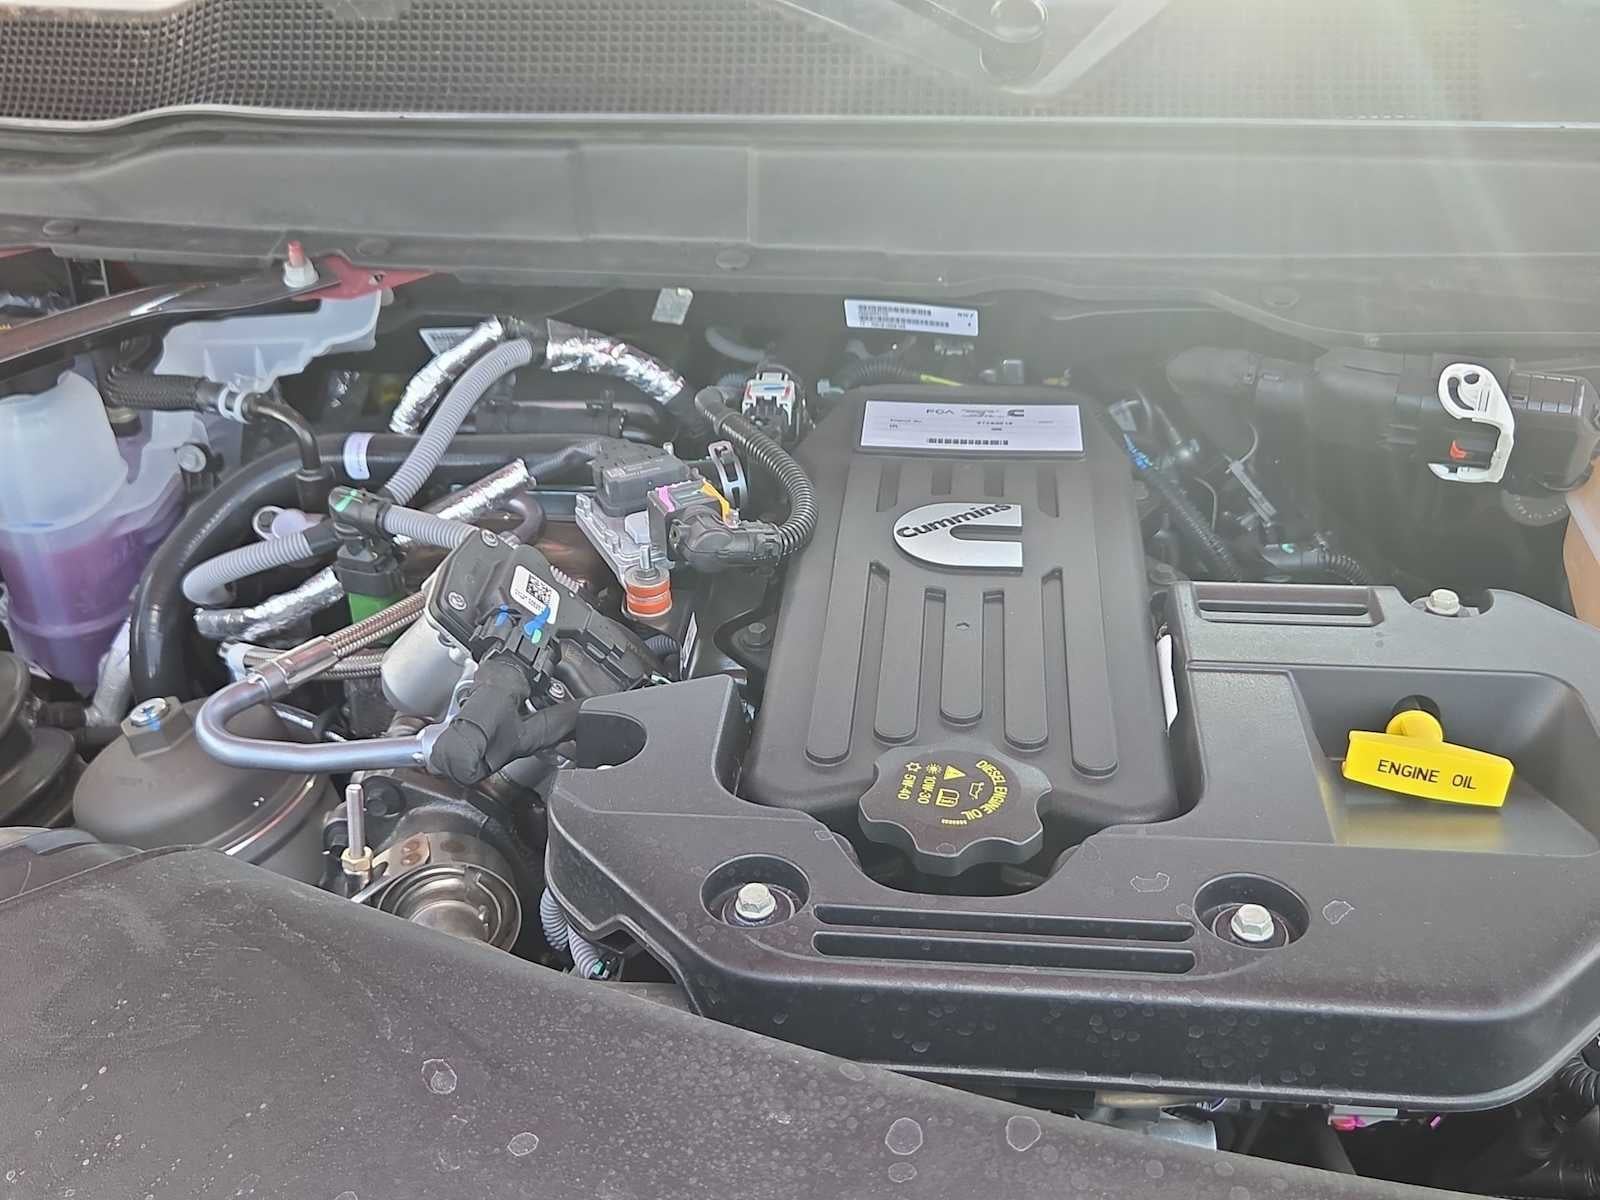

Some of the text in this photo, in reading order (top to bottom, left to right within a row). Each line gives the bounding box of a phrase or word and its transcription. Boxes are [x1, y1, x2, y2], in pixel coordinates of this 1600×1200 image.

[896, 503, 1012, 538] Cummins
[897, 774, 917, 800] 5W-40
[917, 776, 937, 804] 10W-30
[1376, 759, 1477, 790] ENGINE OIL
[960, 760, 1008, 821] DIESEL ENGINE OIL
